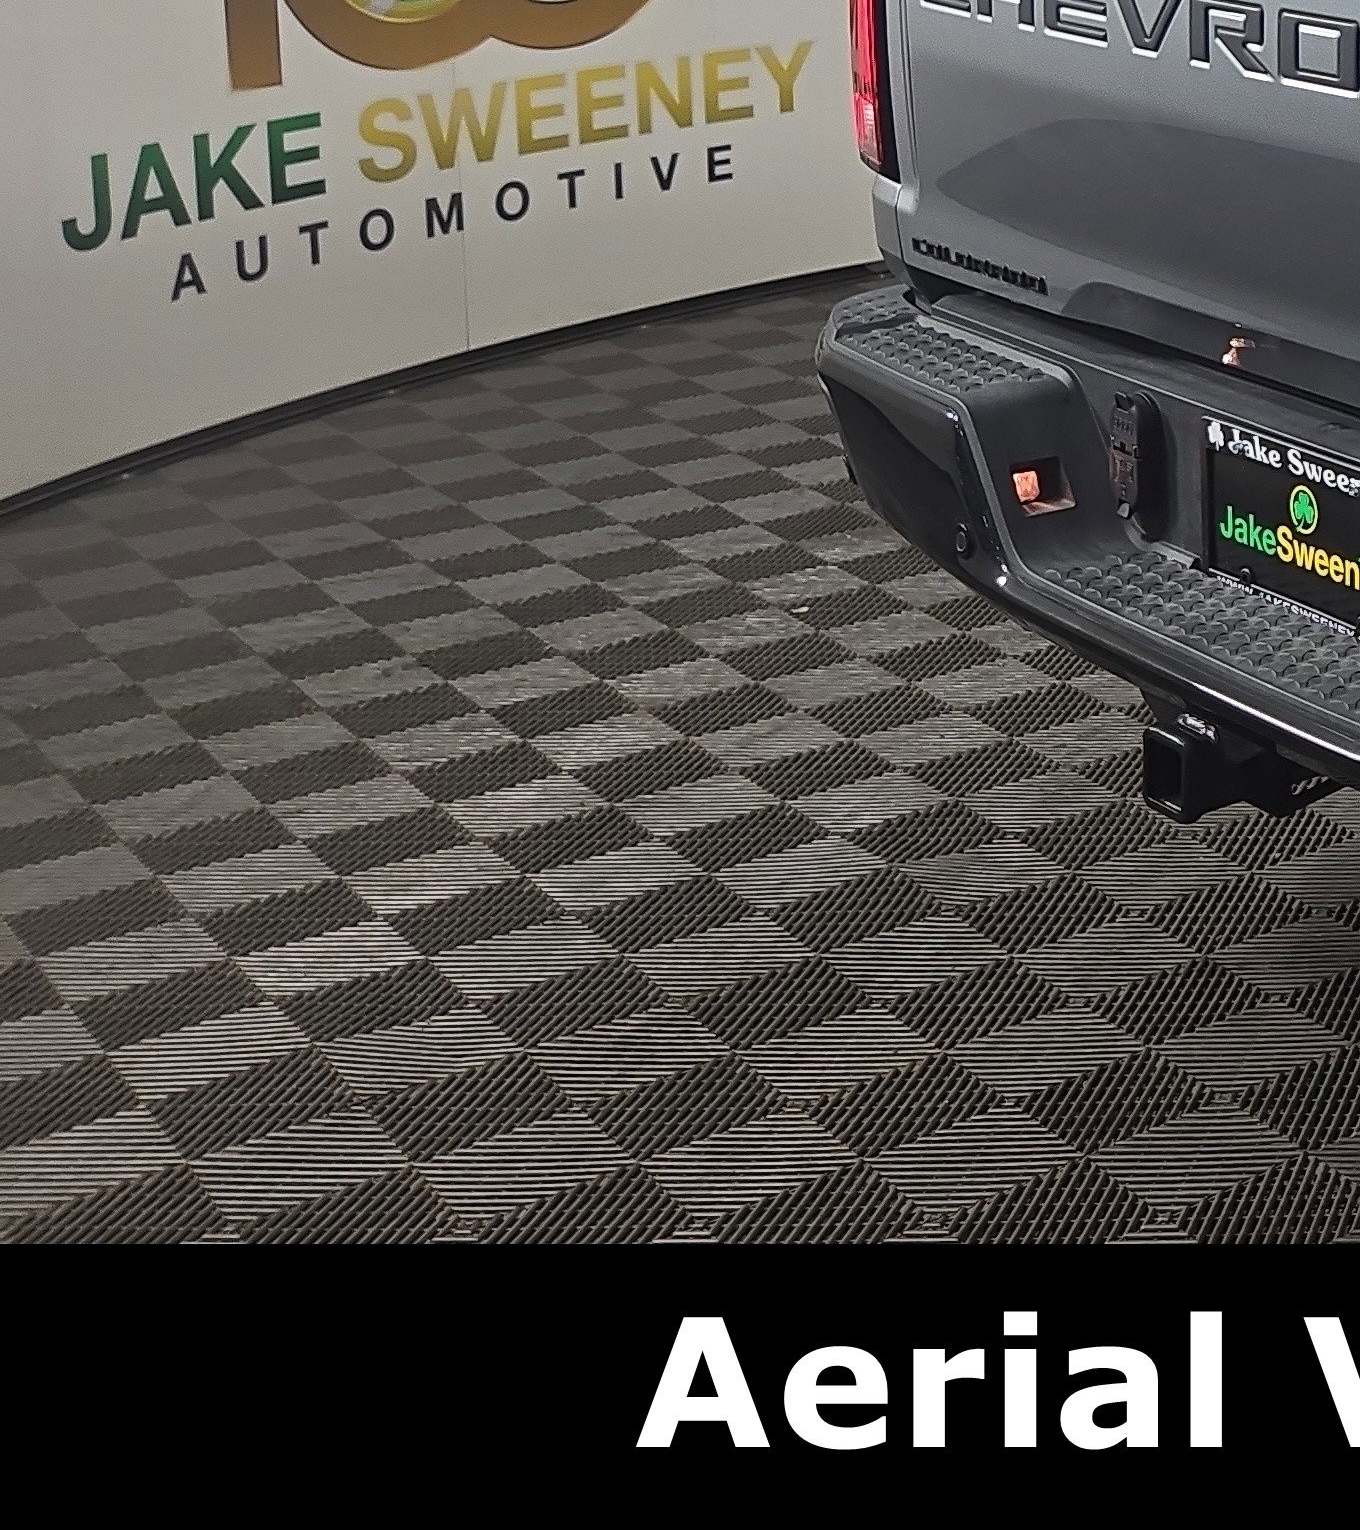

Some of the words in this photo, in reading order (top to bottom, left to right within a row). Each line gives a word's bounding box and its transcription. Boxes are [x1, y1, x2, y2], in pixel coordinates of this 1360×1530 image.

[62, 111, 328, 254] JAKE
[358, 41, 815, 184] SWEENEY
[171, 143, 735, 302] AUTOMOTIVE
[1228, 428, 1283, 468] Jake
